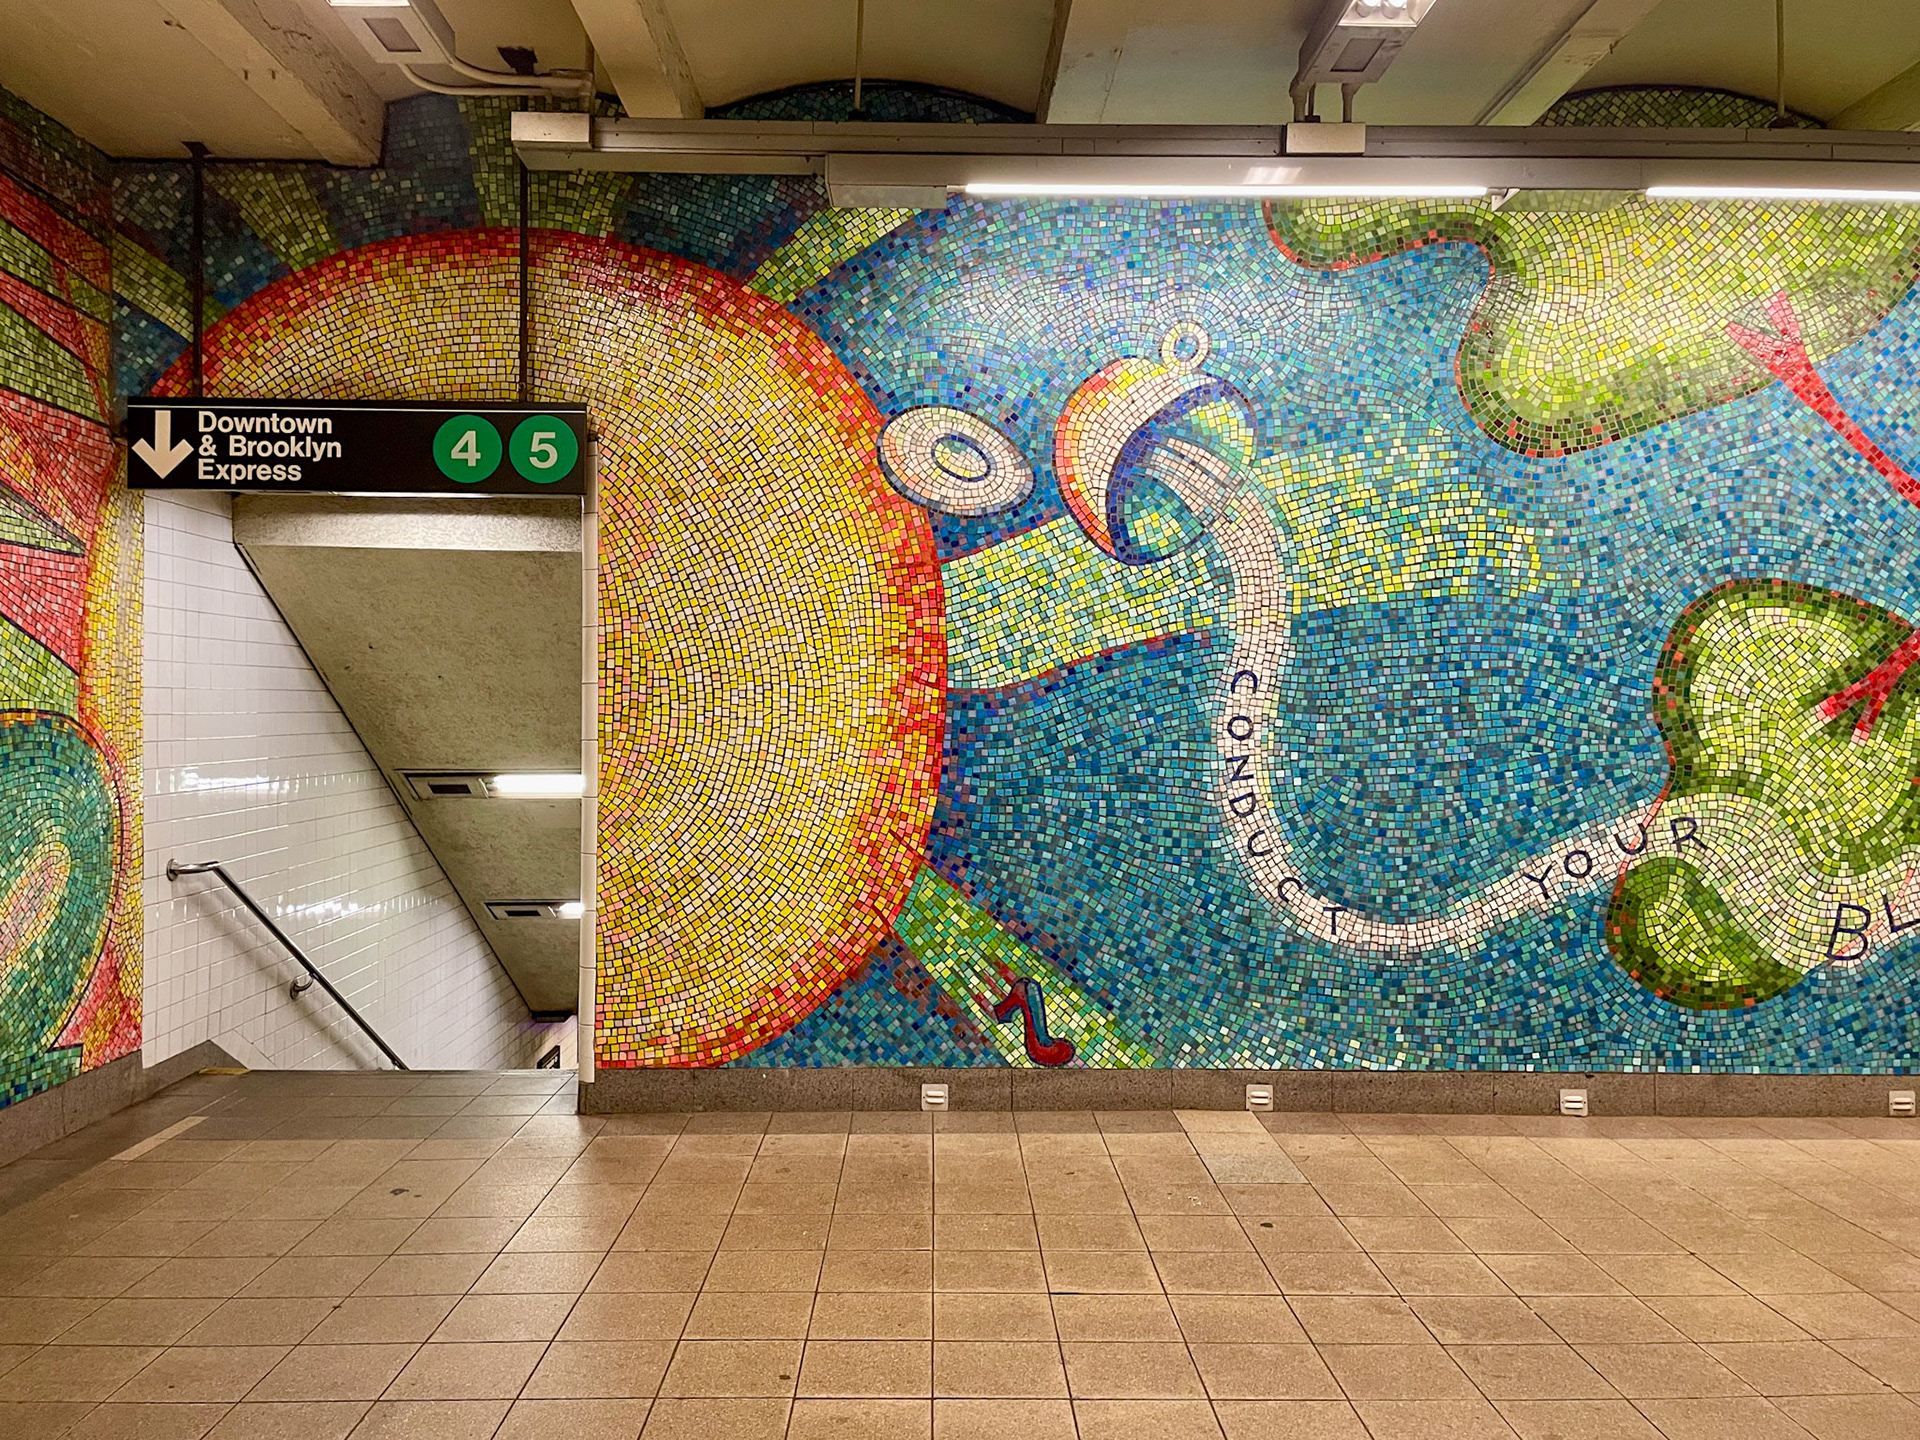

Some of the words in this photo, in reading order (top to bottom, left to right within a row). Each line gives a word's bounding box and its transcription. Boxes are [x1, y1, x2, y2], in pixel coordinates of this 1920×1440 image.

[198, 410, 333, 434] Downtown
[198, 434, 218, 457] &
[229, 434, 342, 462] Brooklyn
[450, 430, 481, 467] 4
[529, 431, 558, 469] 5
[198, 458, 302, 484] Express
[1227, 669, 1348, 936] CONDUCT
[1523, 817, 1706, 899] YOUR
